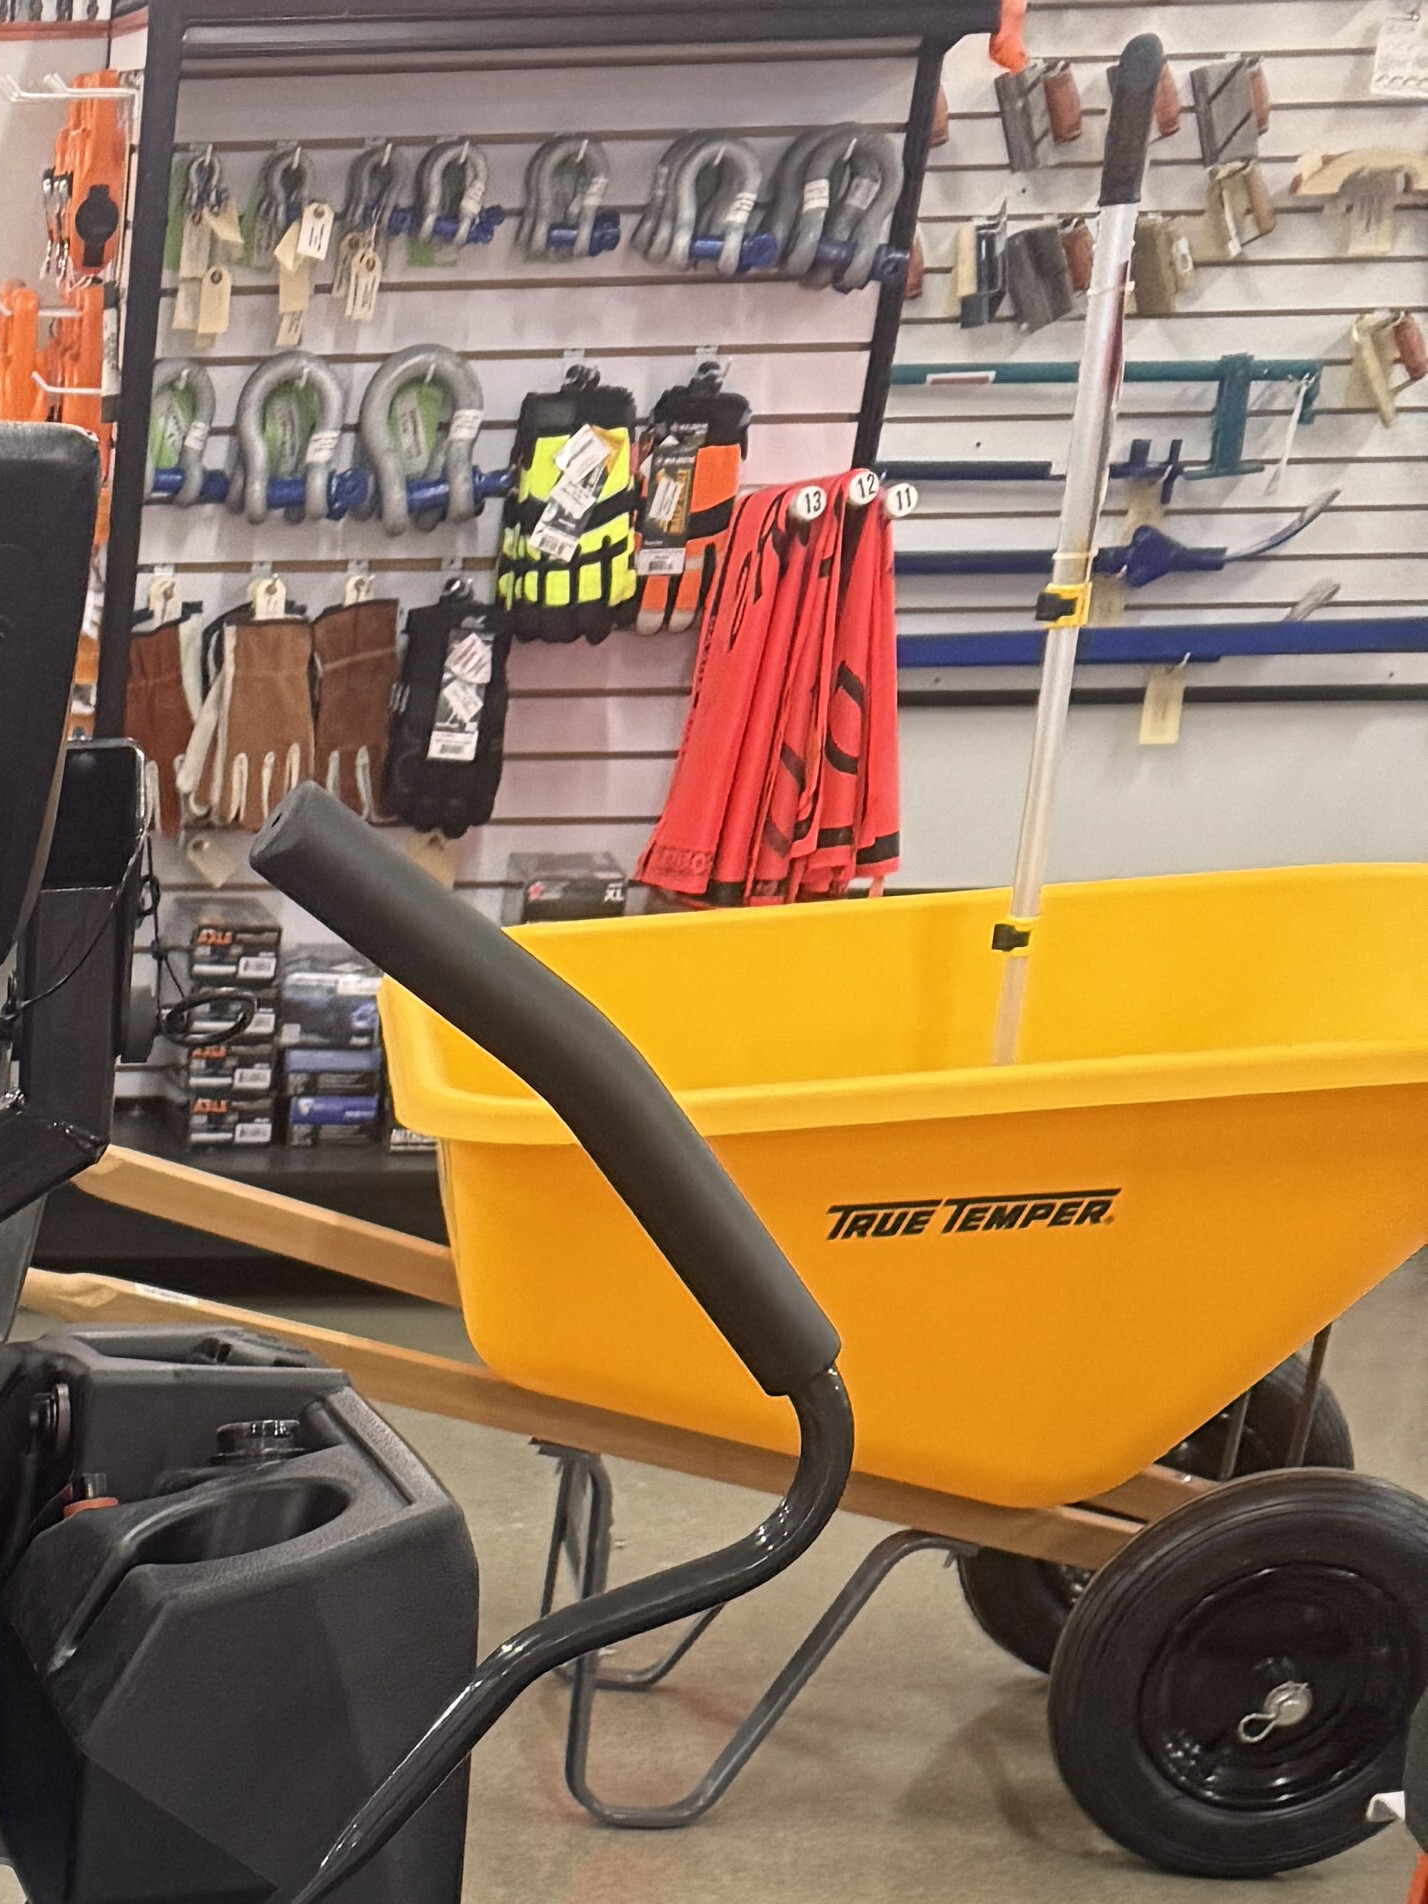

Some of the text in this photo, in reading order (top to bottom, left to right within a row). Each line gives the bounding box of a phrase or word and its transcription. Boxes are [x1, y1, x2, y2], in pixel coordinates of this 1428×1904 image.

[857, 473, 877, 499] 12
[804, 489, 822, 514] 13
[896, 487, 912, 511] 11
[826, 1188, 1122, 1240] TRUE TEMPER
